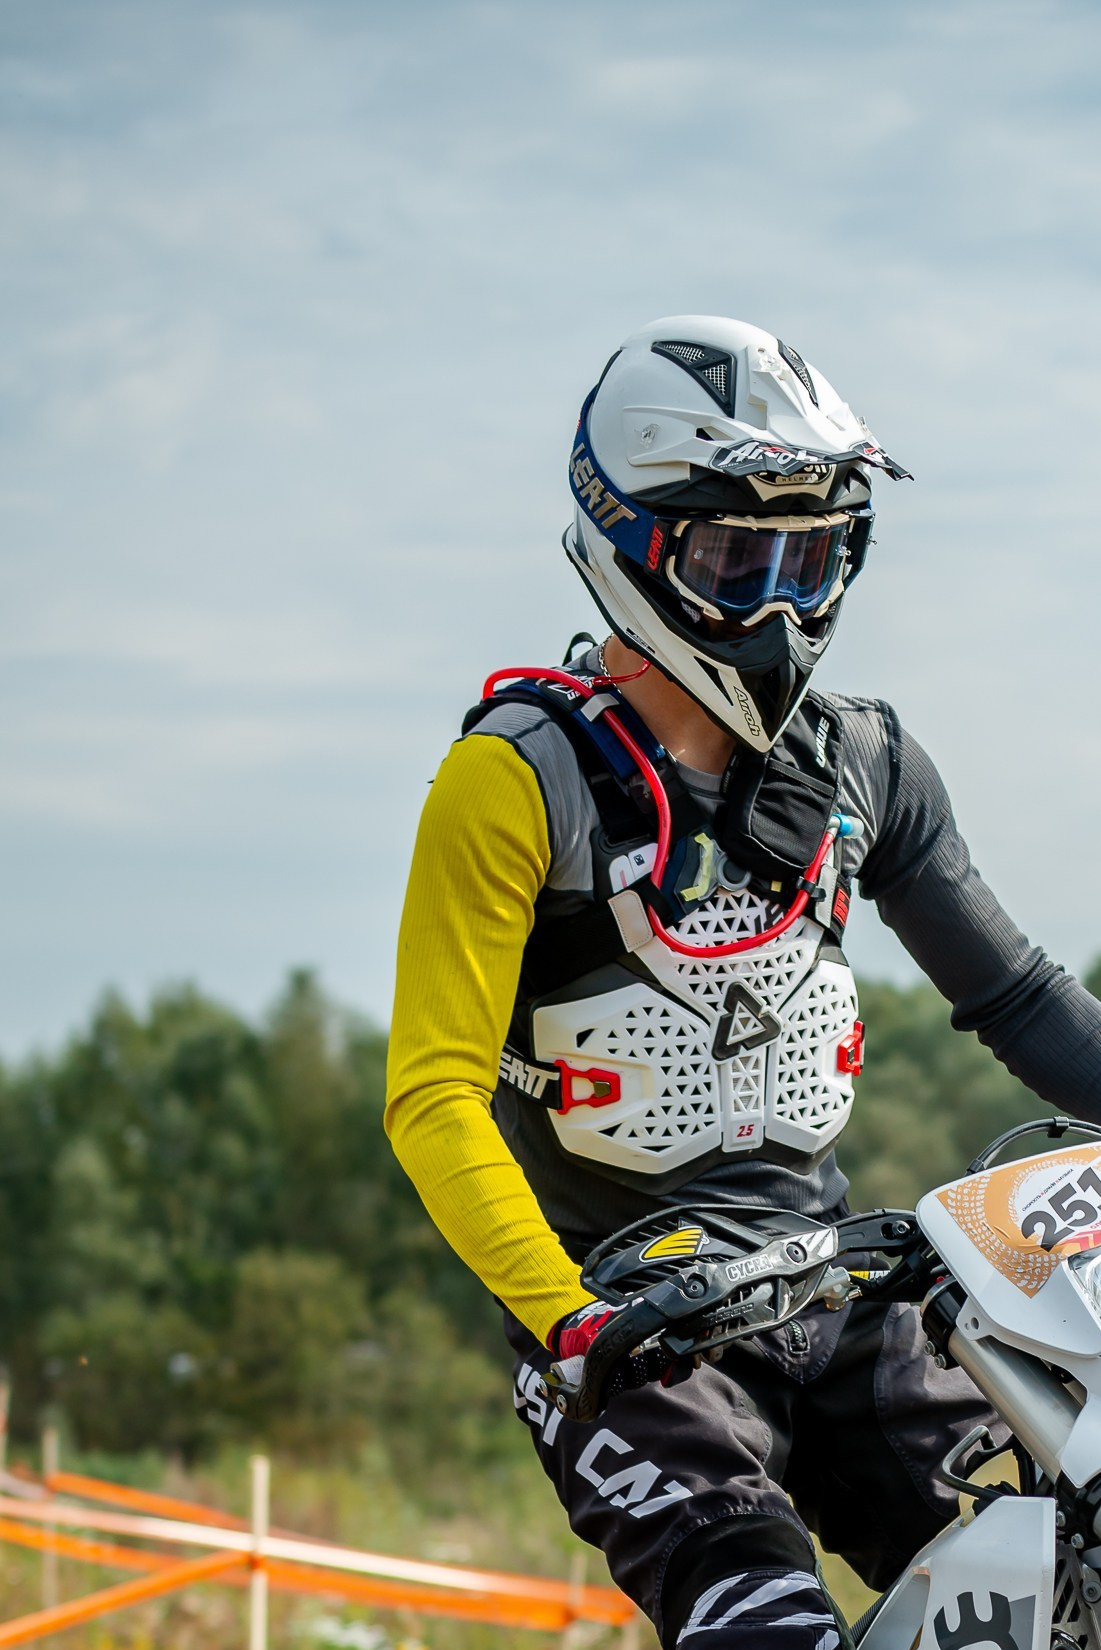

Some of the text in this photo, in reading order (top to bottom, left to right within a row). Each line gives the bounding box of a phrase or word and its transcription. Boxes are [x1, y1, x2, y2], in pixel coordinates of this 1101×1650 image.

[570, 442, 637, 530] LEATT
[646, 524, 664, 571] LEATT
[733, 685, 761, 737] Airoh
[499, 1050, 560, 1099] EATT
